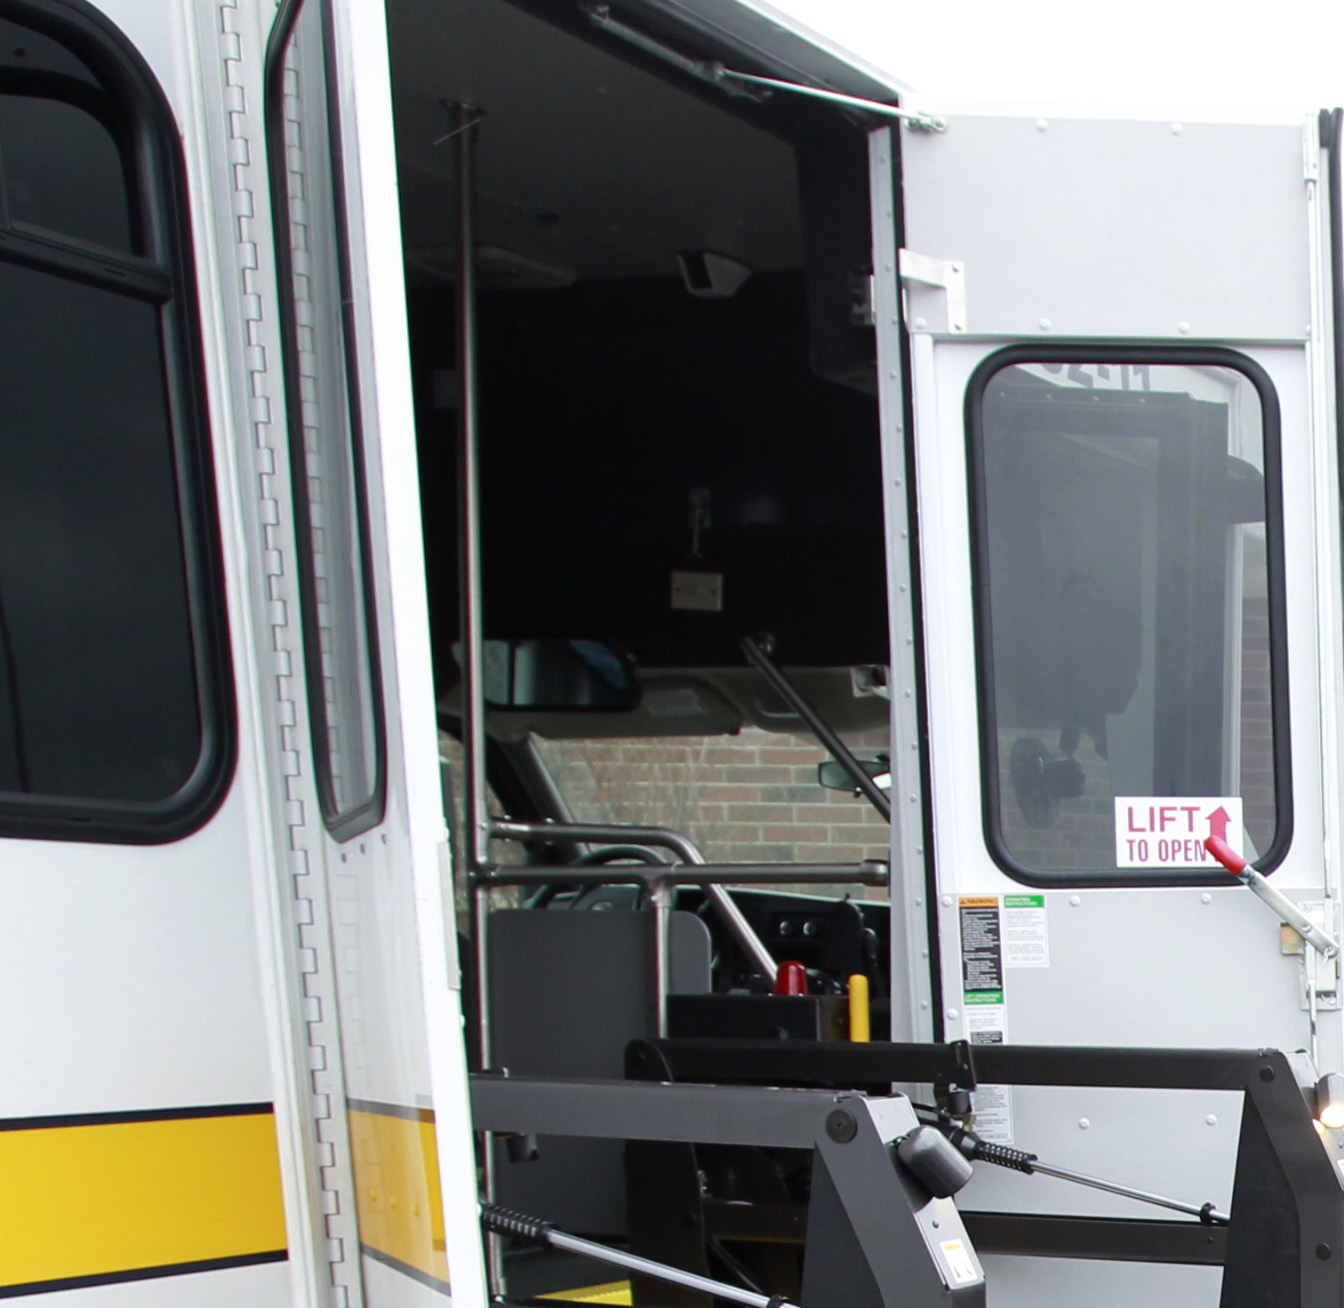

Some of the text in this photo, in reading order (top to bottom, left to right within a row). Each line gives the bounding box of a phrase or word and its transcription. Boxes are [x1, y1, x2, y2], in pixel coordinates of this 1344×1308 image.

[1128, 806, 1200, 832] LIFT
[1127, 839, 1206, 862] TO OPEN
